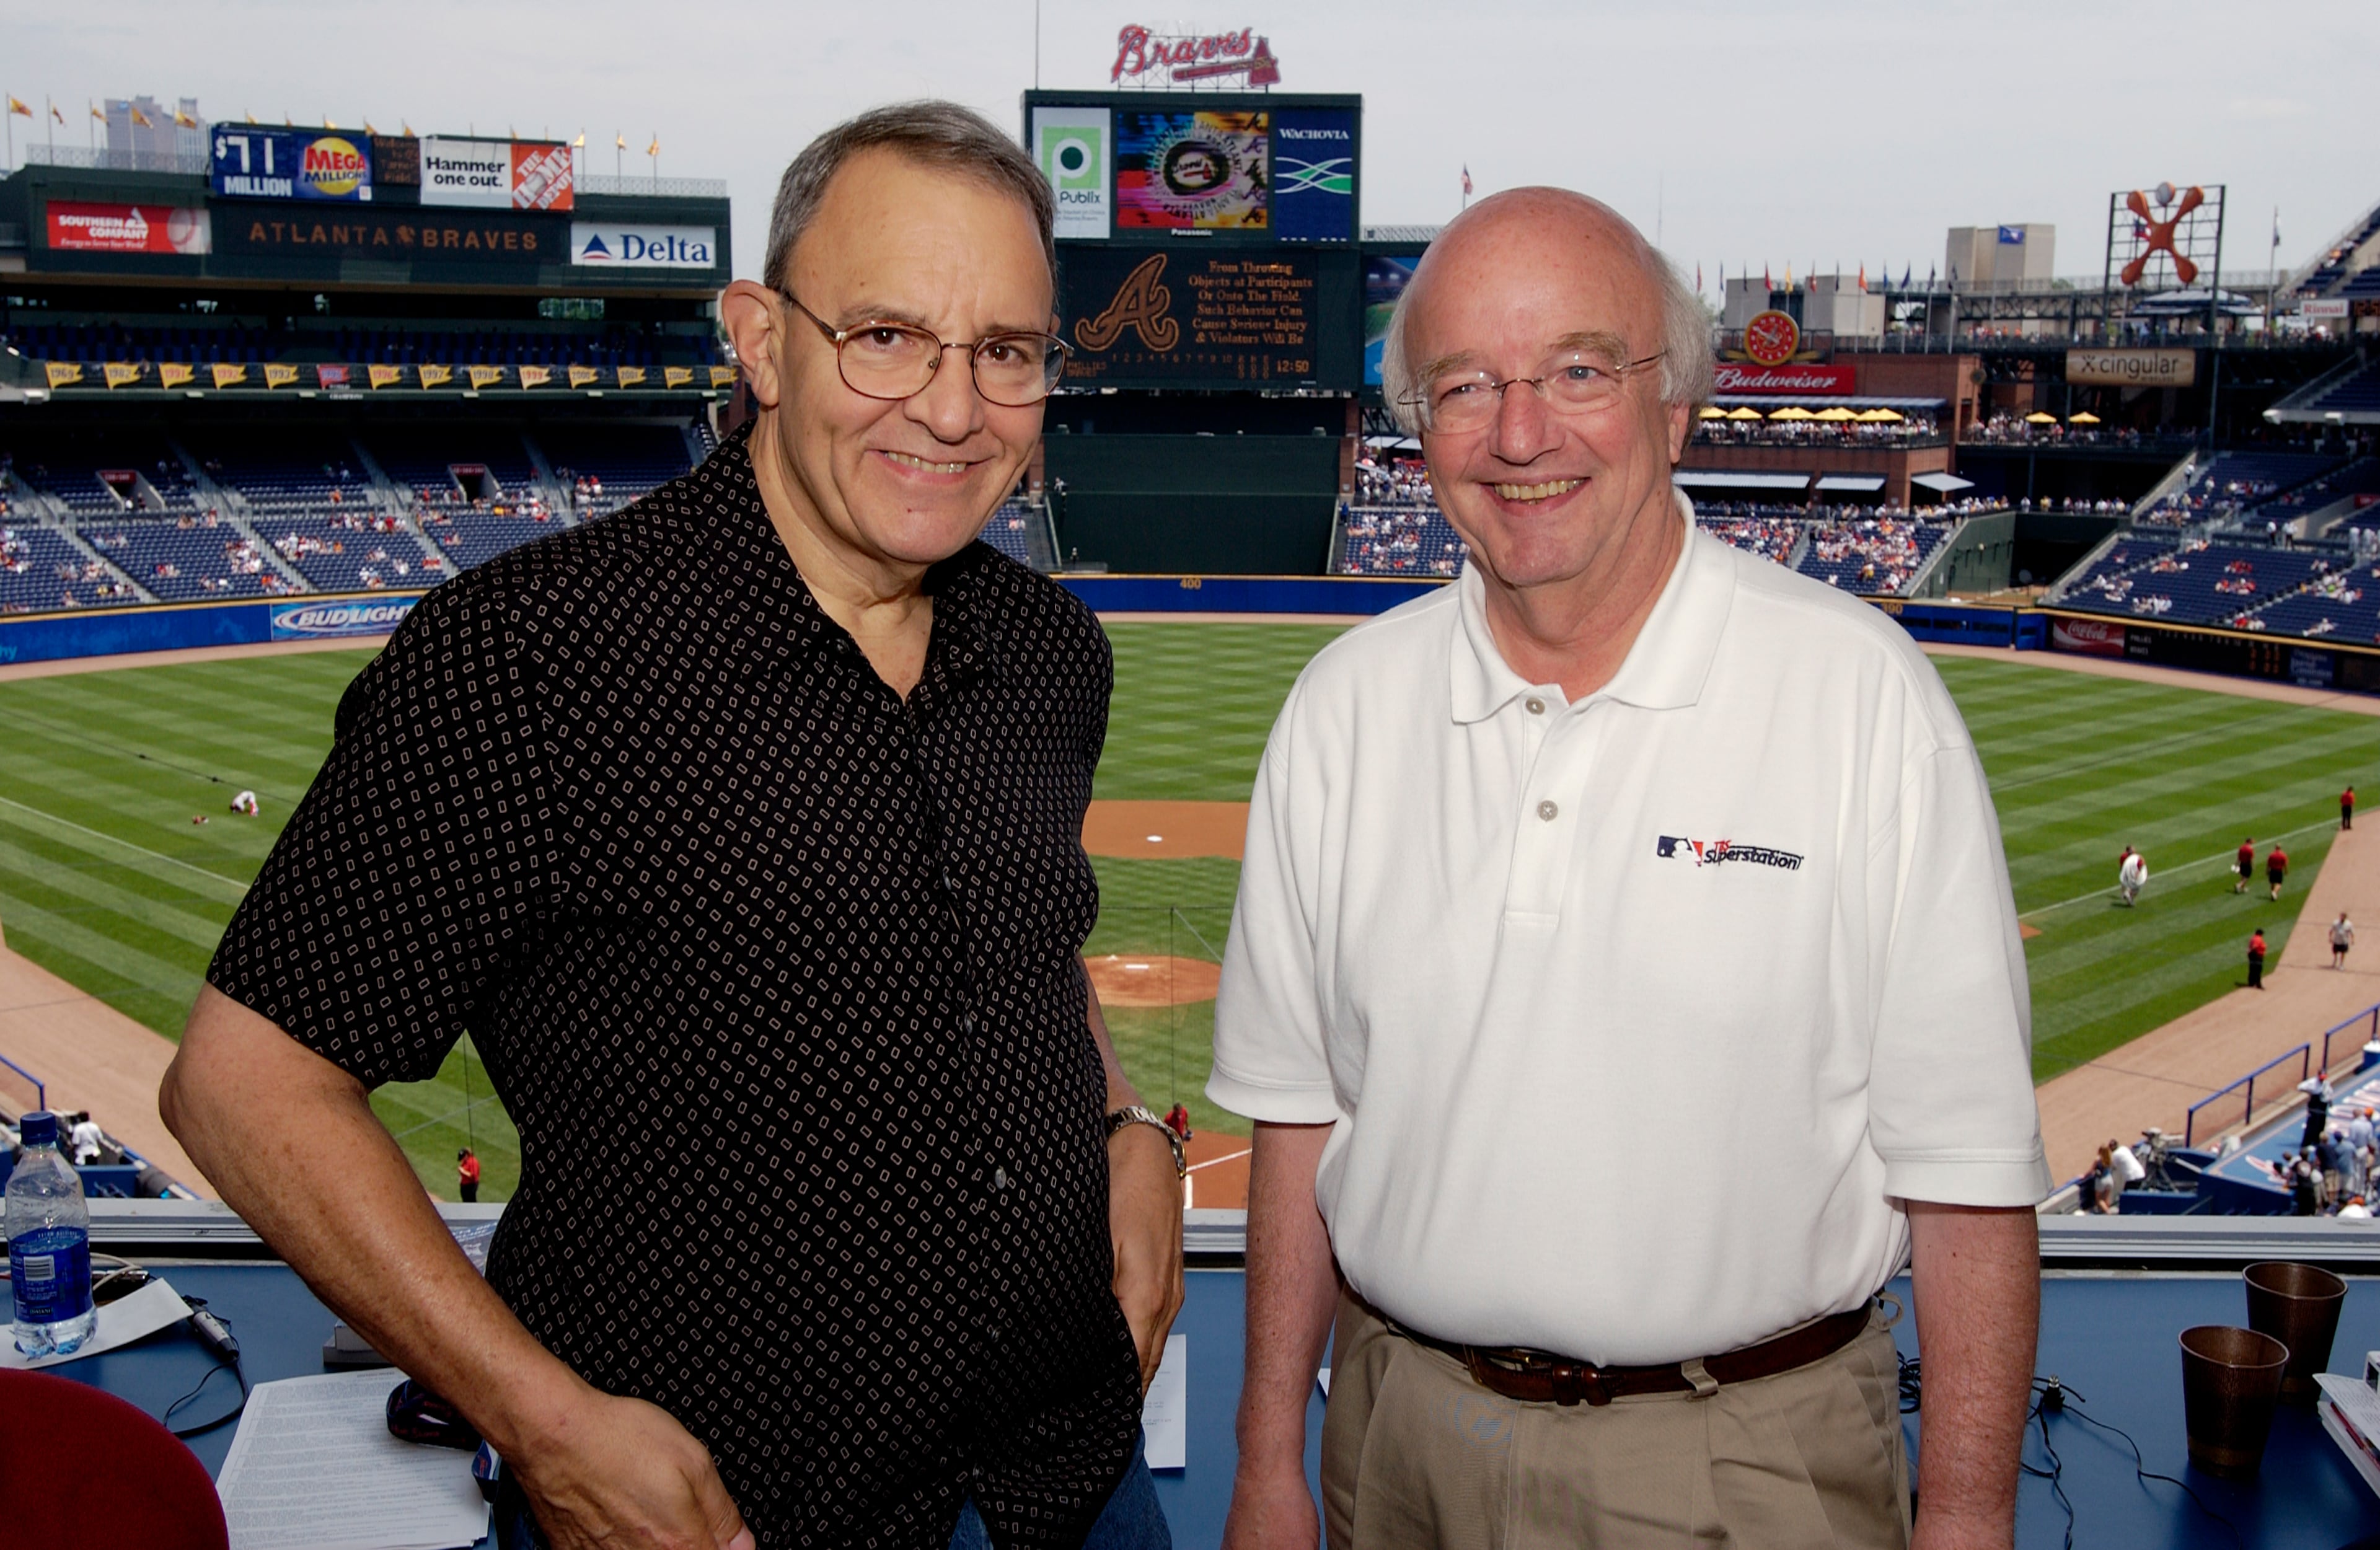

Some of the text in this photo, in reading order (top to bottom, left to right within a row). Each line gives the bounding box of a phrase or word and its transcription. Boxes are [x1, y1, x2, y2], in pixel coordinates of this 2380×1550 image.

[1111, 24, 1253, 83] Braves
[1279, 128, 1349, 139] WACHOVIA
[304, 146, 366, 170] MEGA
[426, 157, 506, 172] Hammer
[516, 150, 545, 175] THE
[304, 170, 367, 183] MILLIONS
[434, 174, 503, 187] one out.
[224, 176, 292, 196] MILLION
[536, 169, 573, 209] DEPOT
[1060, 191, 1101, 203] Publix
[59, 214, 123, 227] SOUTHERN
[89, 227, 148, 240] COMPANY
[249, 222, 537, 250] ATLANTA BRAVES
[620, 234, 710, 263] Delta
[1210, 261, 1292, 275] From Throwing
[1188, 275, 1230, 288] Objects
[1248, 276, 1313, 289] Participants
[1198, 290, 1212, 301] Or
[1217, 291, 1243, 301] Onto
[1248, 291, 1267, 301] The
[1197, 304, 1302, 315] Such Behavior Can
[2304, 304, 2343, 314] Rinnai
[1192, 318, 1227, 329] Cause
[1274, 319, 1307, 331] Injury
[1196, 332, 1303, 344] & Violators Will Be
[1277, 359, 1309, 372] 12:50
[2100, 351, 2178, 379] cingular
[164, 368, 185, 379] 1991
[217, 368, 239, 380] 1992
[522, 369, 543, 381] 1999
[1715, 368, 1837, 389] Budweiser
[1180, 578, 1202, 589] 400
[298, 610, 349, 627] BUD
[2068, 620, 2107, 640] Coca-Cola
